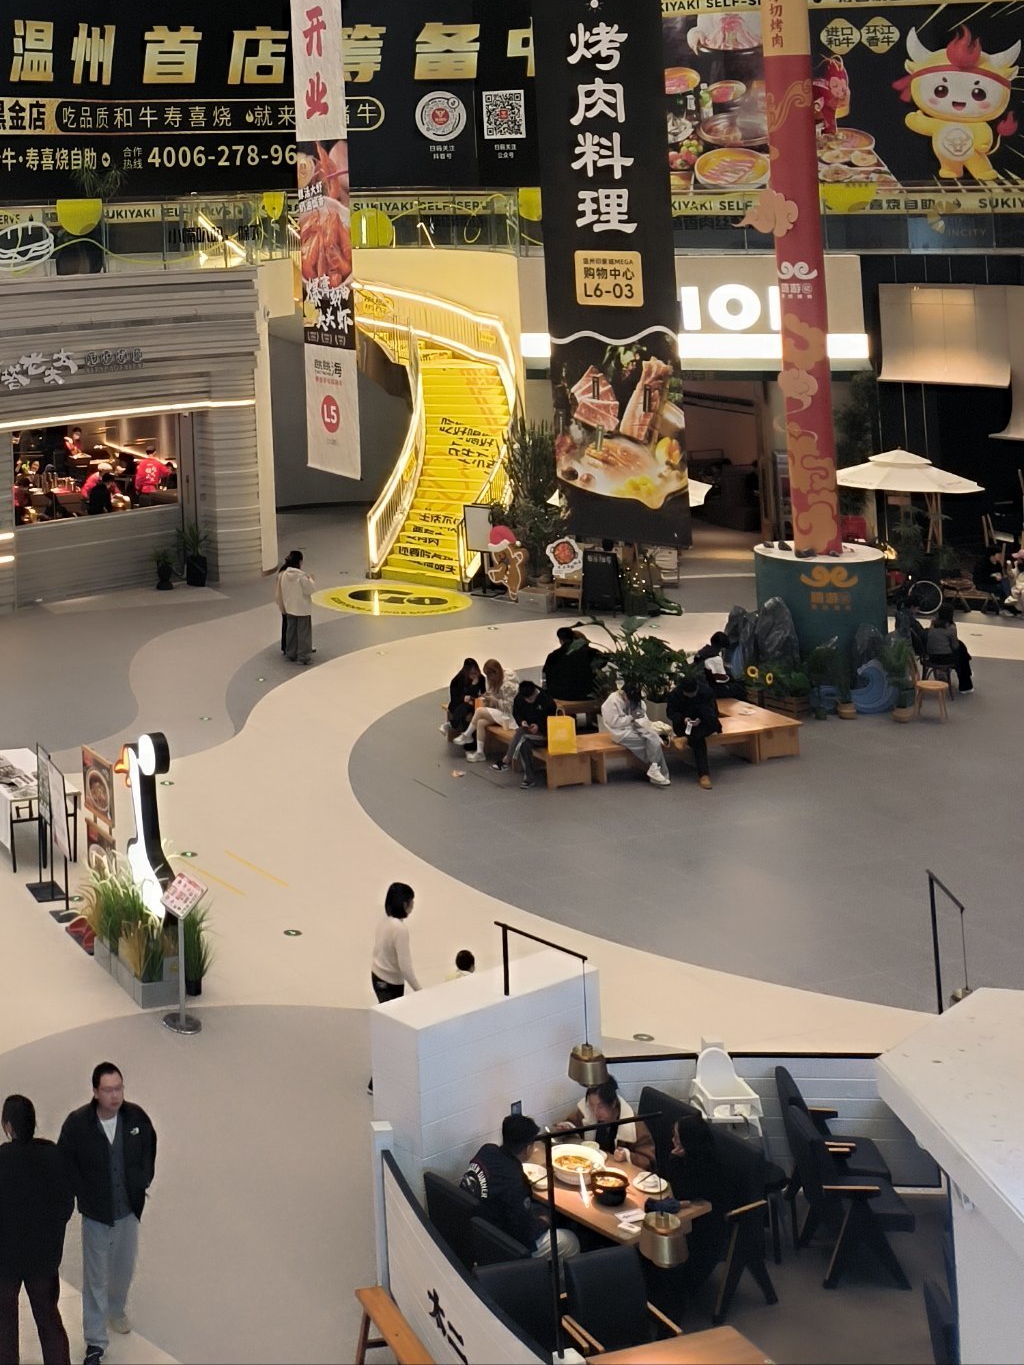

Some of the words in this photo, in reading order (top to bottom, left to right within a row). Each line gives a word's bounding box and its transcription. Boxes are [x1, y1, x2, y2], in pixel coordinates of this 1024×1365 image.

[825, 35, 855, 48] 和牛
[62, 105, 232, 130] 吃品质和牛寿喜烧
[122, 146, 143, 157] 合作
[122, 158, 143, 170] 热线
[583, 266, 635, 280] 购物中心
[583, 282, 635, 299] L6-03
[323, 403, 338, 424] L5
